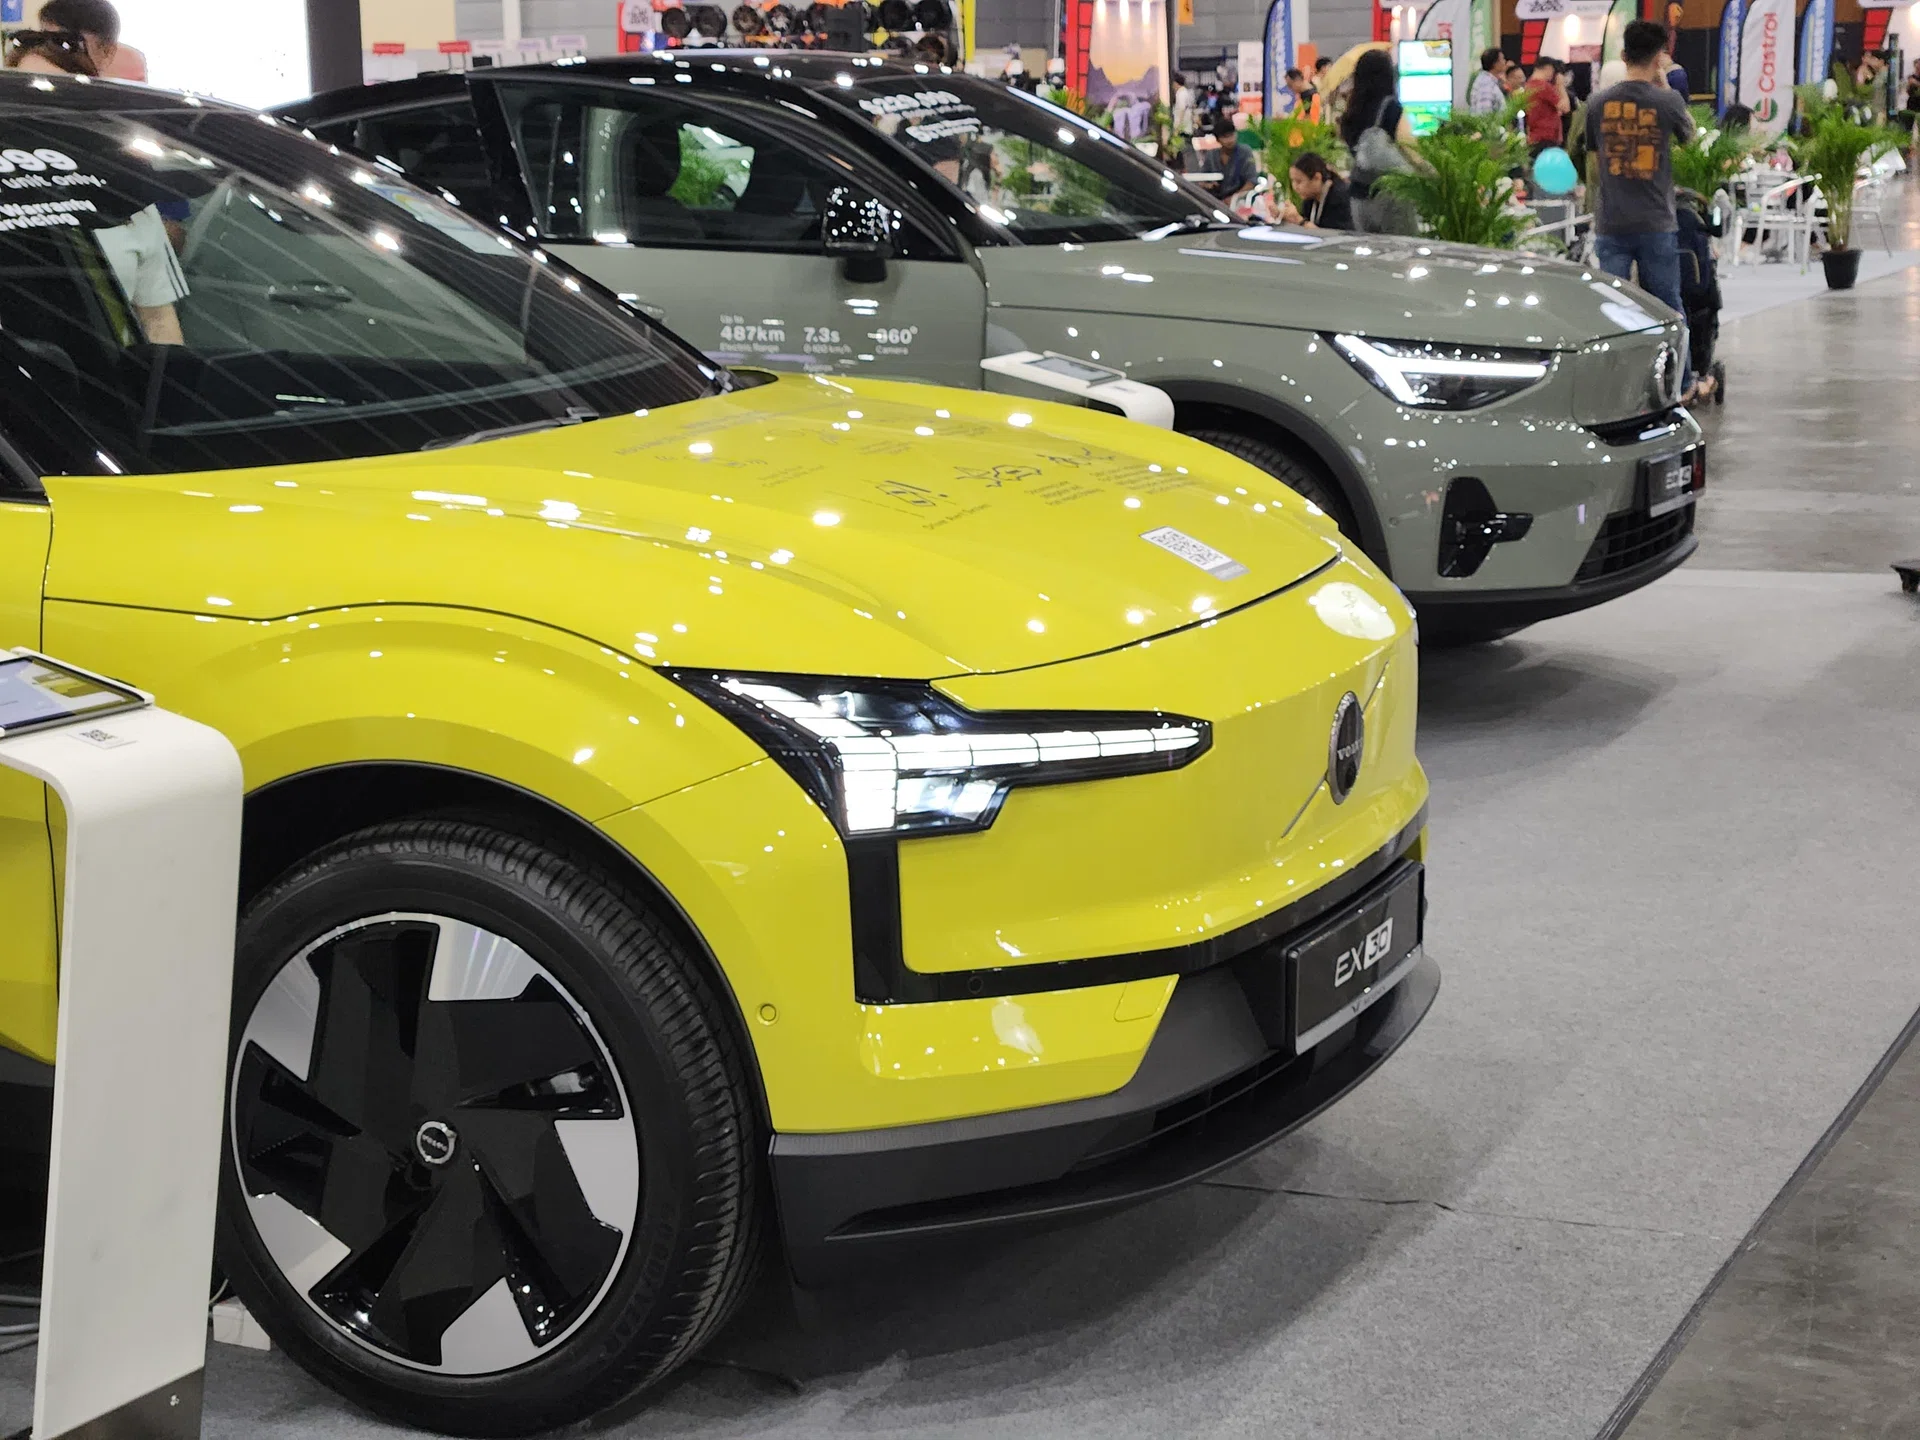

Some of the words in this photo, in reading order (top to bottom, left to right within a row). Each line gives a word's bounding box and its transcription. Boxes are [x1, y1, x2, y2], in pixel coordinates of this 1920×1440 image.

[1759, 12, 1777, 93] Castrol
[51, 171, 107, 188] only.
[720, 325, 785, 342] 487km
[803, 326, 840, 343] 7.3s
[1334, 917, 1394, 988] EX30
